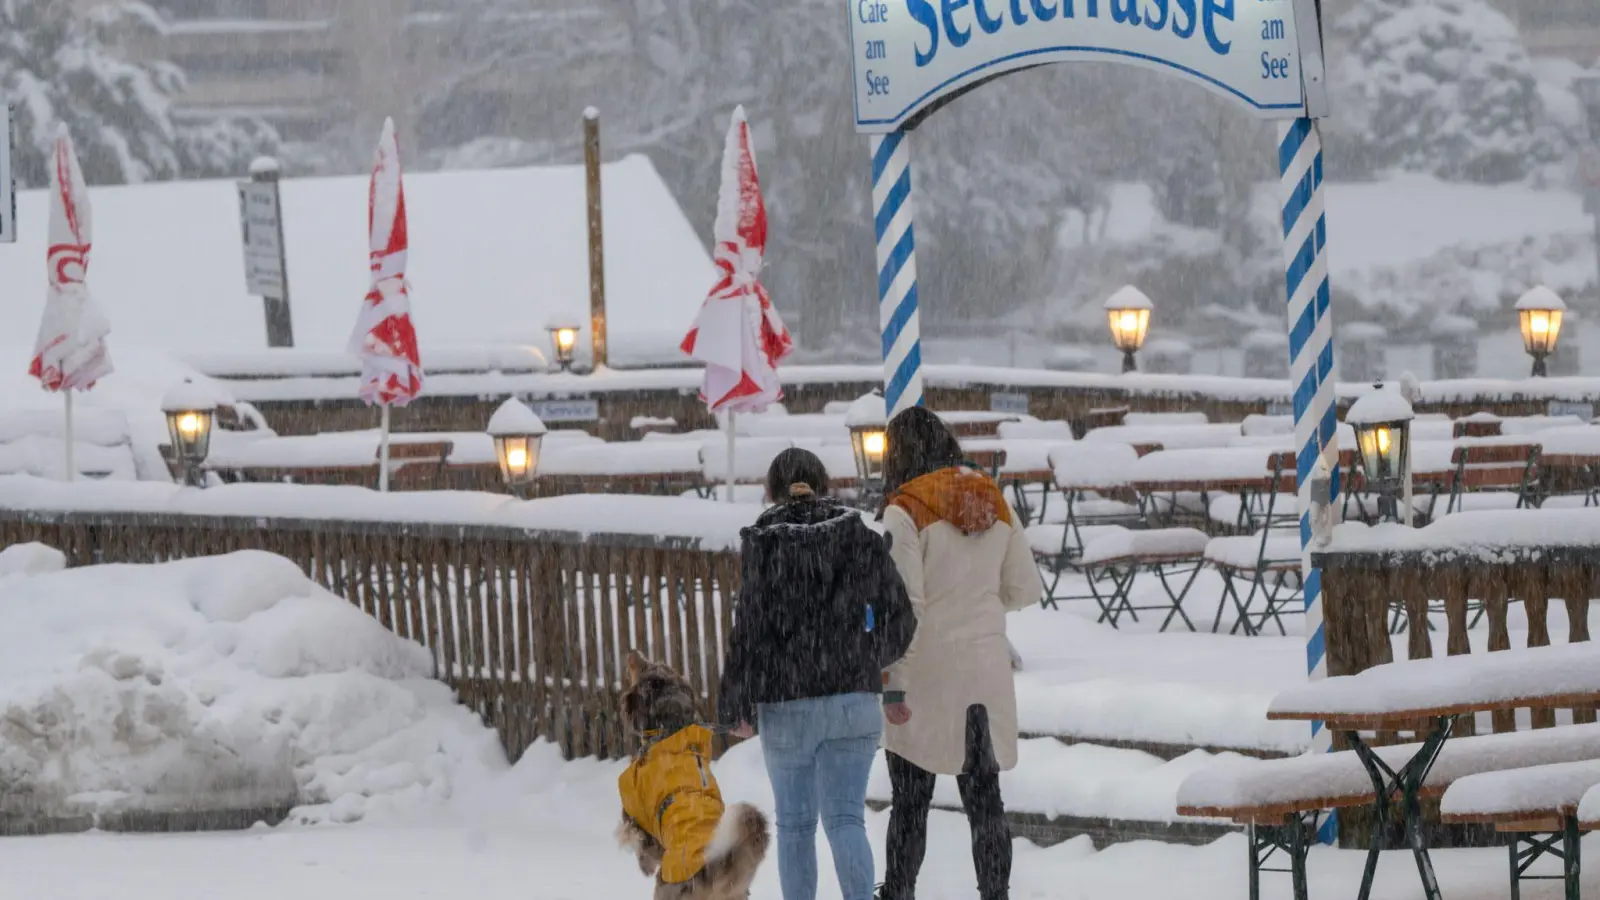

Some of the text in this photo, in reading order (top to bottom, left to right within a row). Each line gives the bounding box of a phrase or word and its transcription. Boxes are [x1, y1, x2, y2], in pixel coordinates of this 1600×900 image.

[1261, 18, 1285, 40] am
[866, 39, 886, 60] am
[1261, 51, 1289, 79] See
[866, 69, 890, 96] See
